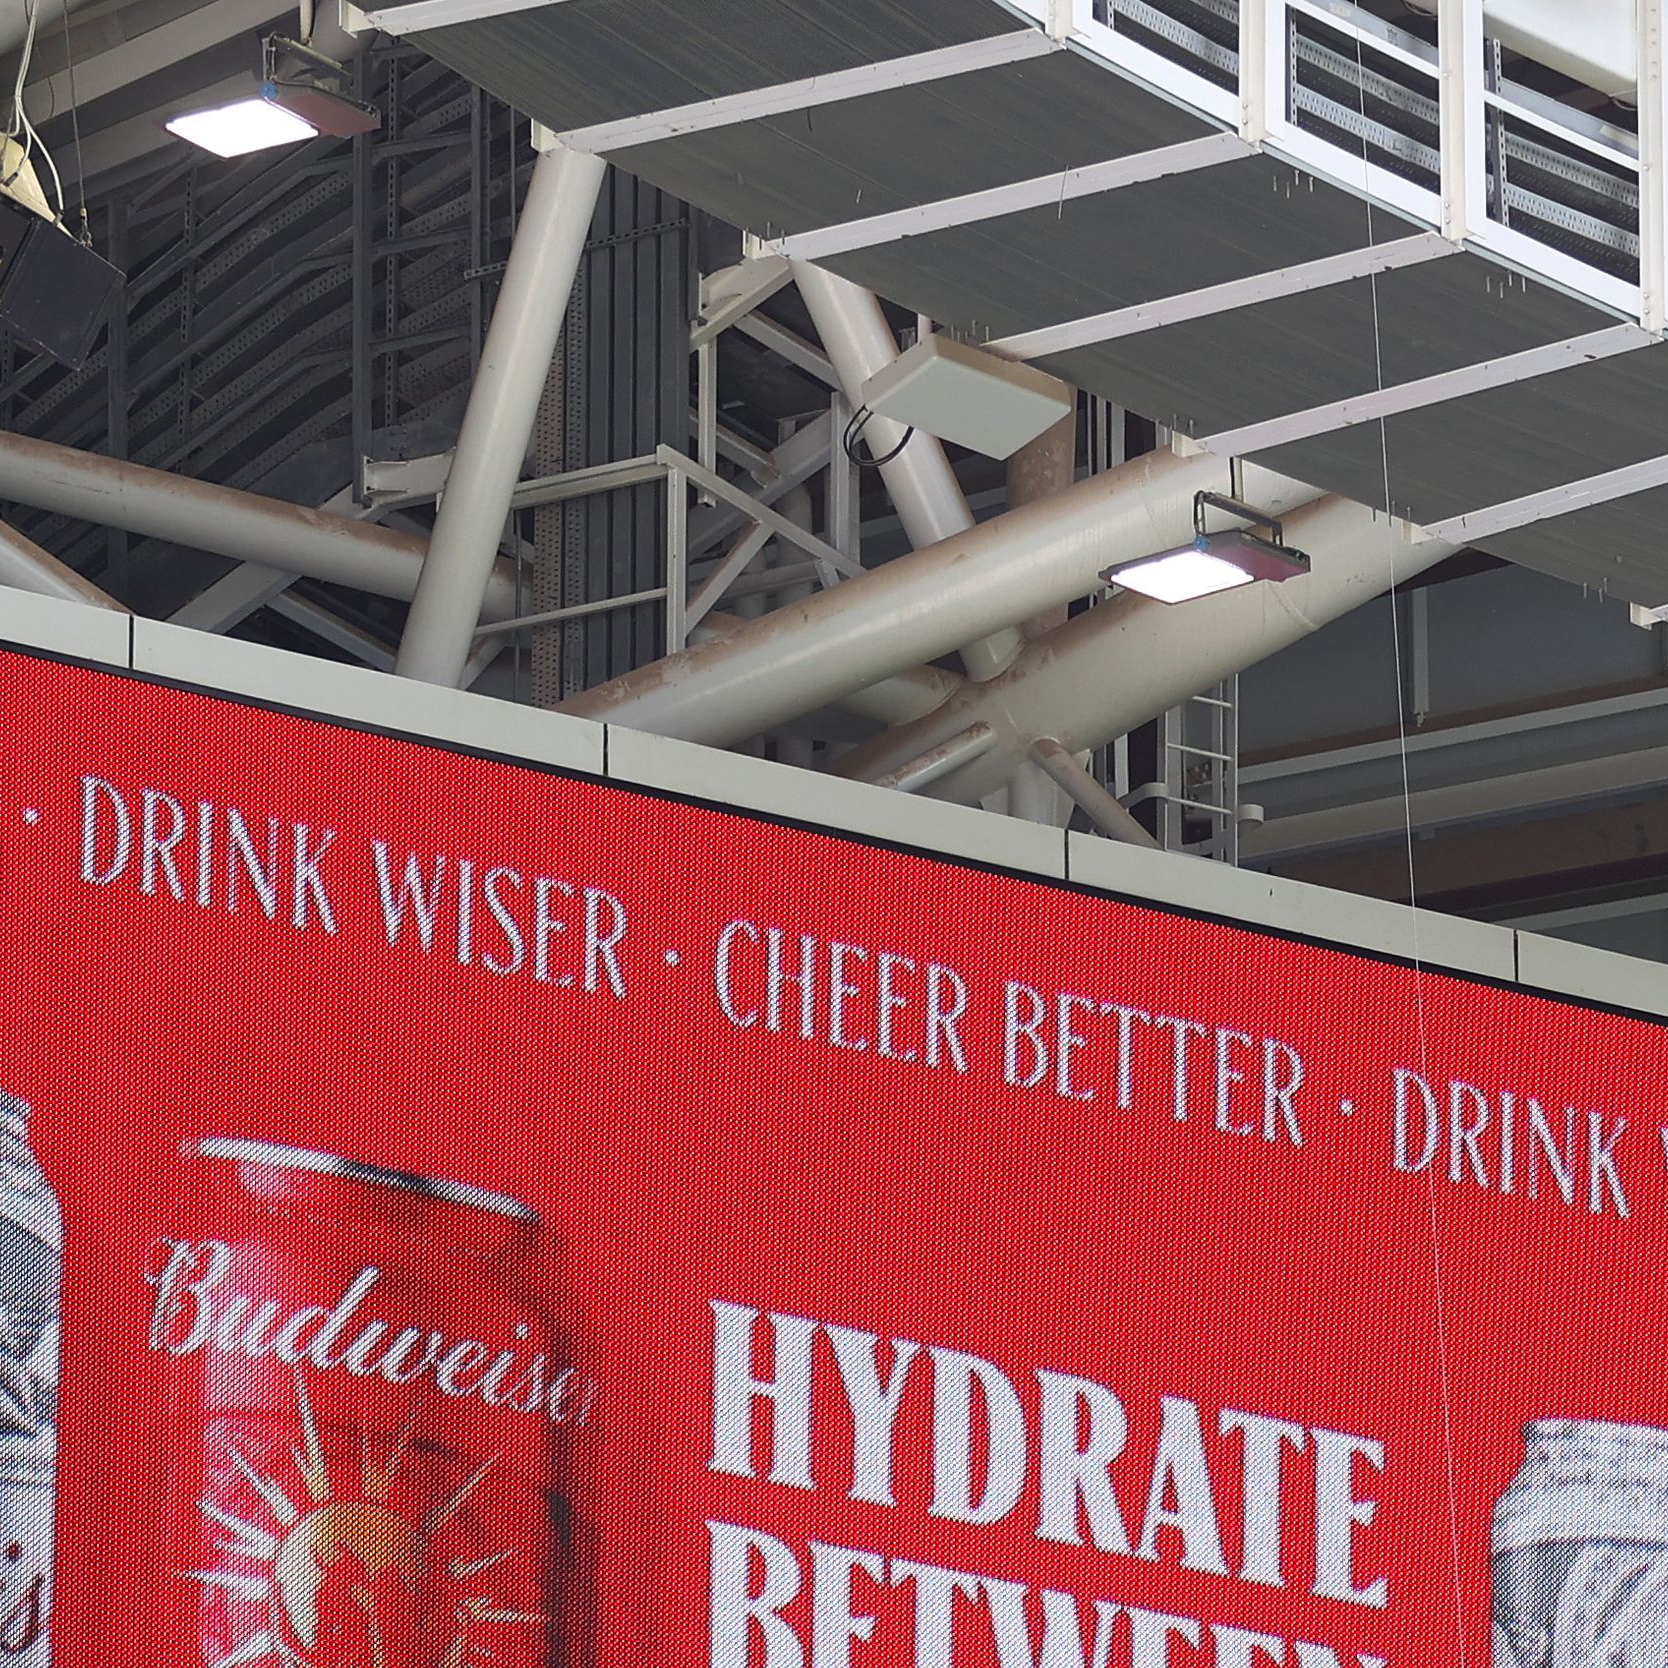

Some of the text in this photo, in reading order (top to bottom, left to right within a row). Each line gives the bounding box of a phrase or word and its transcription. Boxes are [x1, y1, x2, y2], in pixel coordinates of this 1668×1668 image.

[81, 775, 337, 935] DRINK
[371, 840, 628, 999] WISER
[713, 920, 969, 1074] CHEER
[1003, 980, 1305, 1147] BETTER
[1392, 1067, 1631, 1219] DRINK
[706, 1298, 1390, 1611] HYDRATE
